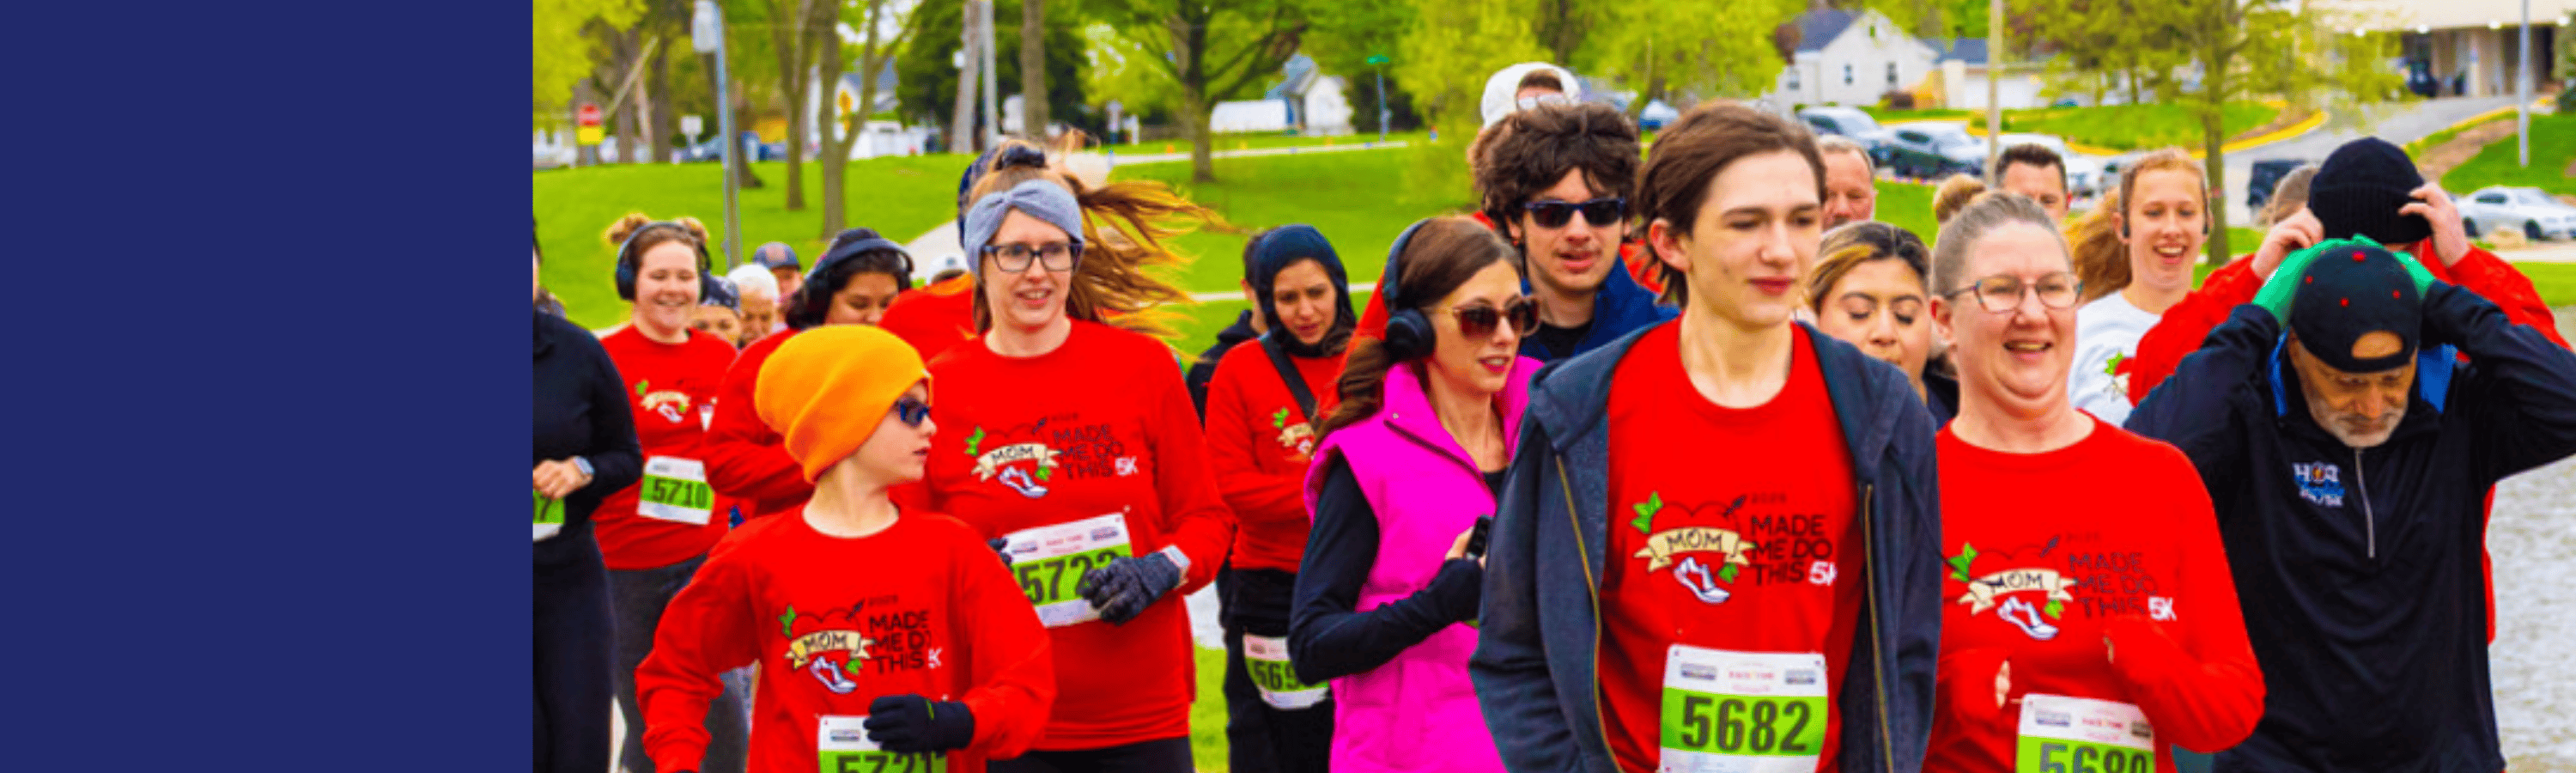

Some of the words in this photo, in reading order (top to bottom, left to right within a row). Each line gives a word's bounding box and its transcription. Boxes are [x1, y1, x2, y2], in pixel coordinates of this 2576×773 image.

[1054, 424, 1114, 444] MADE
[991, 445, 1033, 460] MOM
[1059, 443, 1089, 461] ME
[1094, 441, 1125, 458] DO
[1064, 459, 1113, 479] THIS
[1115, 456, 1139, 477] 5K
[652, 478, 708, 509] 5710
[1750, 514, 1826, 537] MADE
[1666, 527, 1722, 551] MOM
[1751, 538, 1788, 561] ME
[1792, 537, 1832, 560] DO
[1750, 561, 1805, 586] THIS
[2069, 552, 2145, 574] MADE
[2074, 574, 2114, 594] ME
[2121, 575, 2157, 595] DO
[2078, 597, 2146, 620] THIS
[2148, 596, 2178, 622] 5K
[869, 610, 929, 633] MADE
[803, 631, 847, 649] MOM
[872, 632, 902, 654] ME
[872, 651, 925, 674] THIS
[1254, 660, 1299, 691] 569
[1681, 696, 1812, 752] 5682
